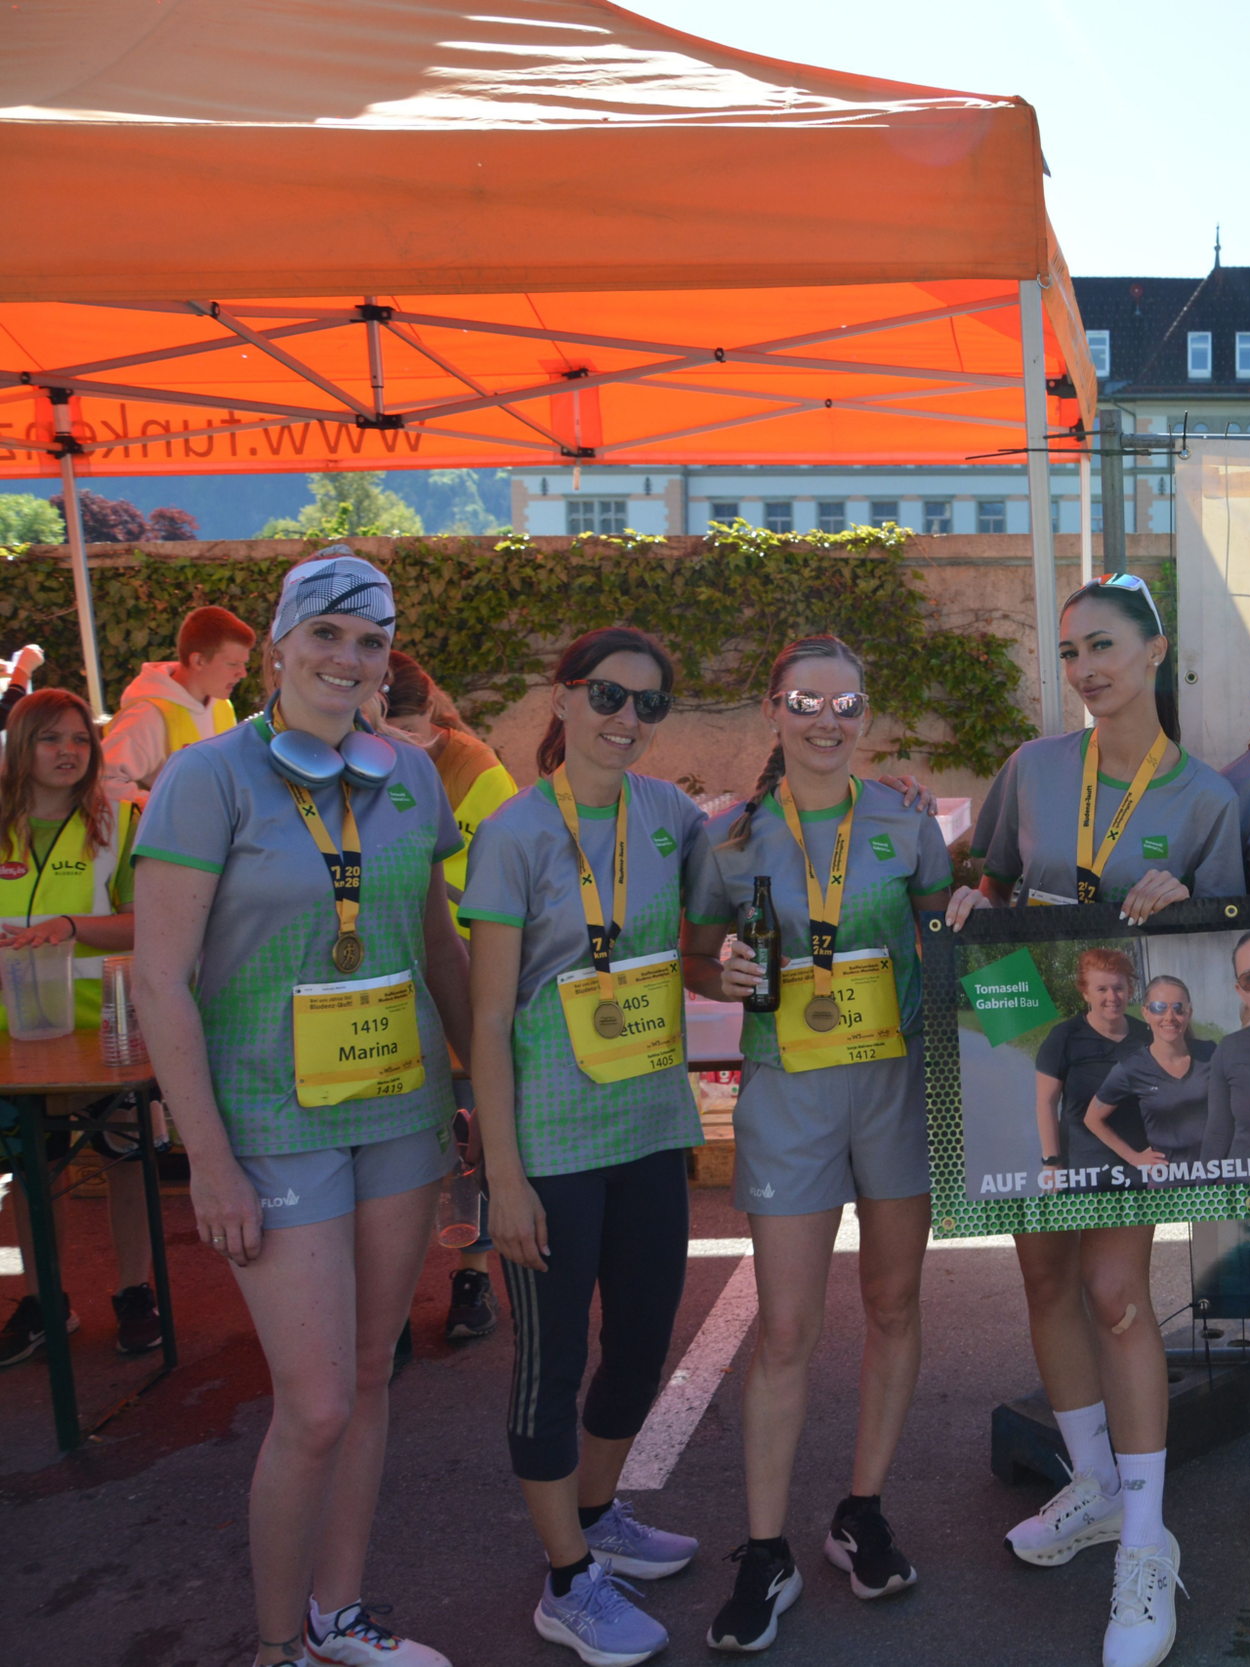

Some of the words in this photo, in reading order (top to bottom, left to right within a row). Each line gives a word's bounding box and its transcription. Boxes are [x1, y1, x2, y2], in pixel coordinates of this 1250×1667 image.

[52, 860, 87, 872] ULC
[331, 865, 341, 879] 7
[345, 866, 360, 877] 20
[345, 877, 360, 888] 26
[1088, 886, 1096, 898] 7
[592, 938, 603, 951] 7
[822, 935, 832, 948] 7
[594, 952, 607, 960] km
[819, 948, 832, 956] km
[830, 988, 856, 1002] 412
[974, 982, 1029, 995] Tomaselli
[615, 995, 650, 1011] 405
[976, 997, 1018, 1010] Gabriel
[1020, 997, 1039, 1007] Bau
[838, 1010, 863, 1027] nja
[351, 1016, 389, 1036] 1419
[619, 1017, 666, 1037] ettina
[339, 1041, 398, 1062] Marina
[849, 1049, 876, 1062] 1412
[650, 1055, 674, 1069] 1405
[377, 1082, 403, 1095] 1419
[980, 1172, 1027, 1194] AUF
